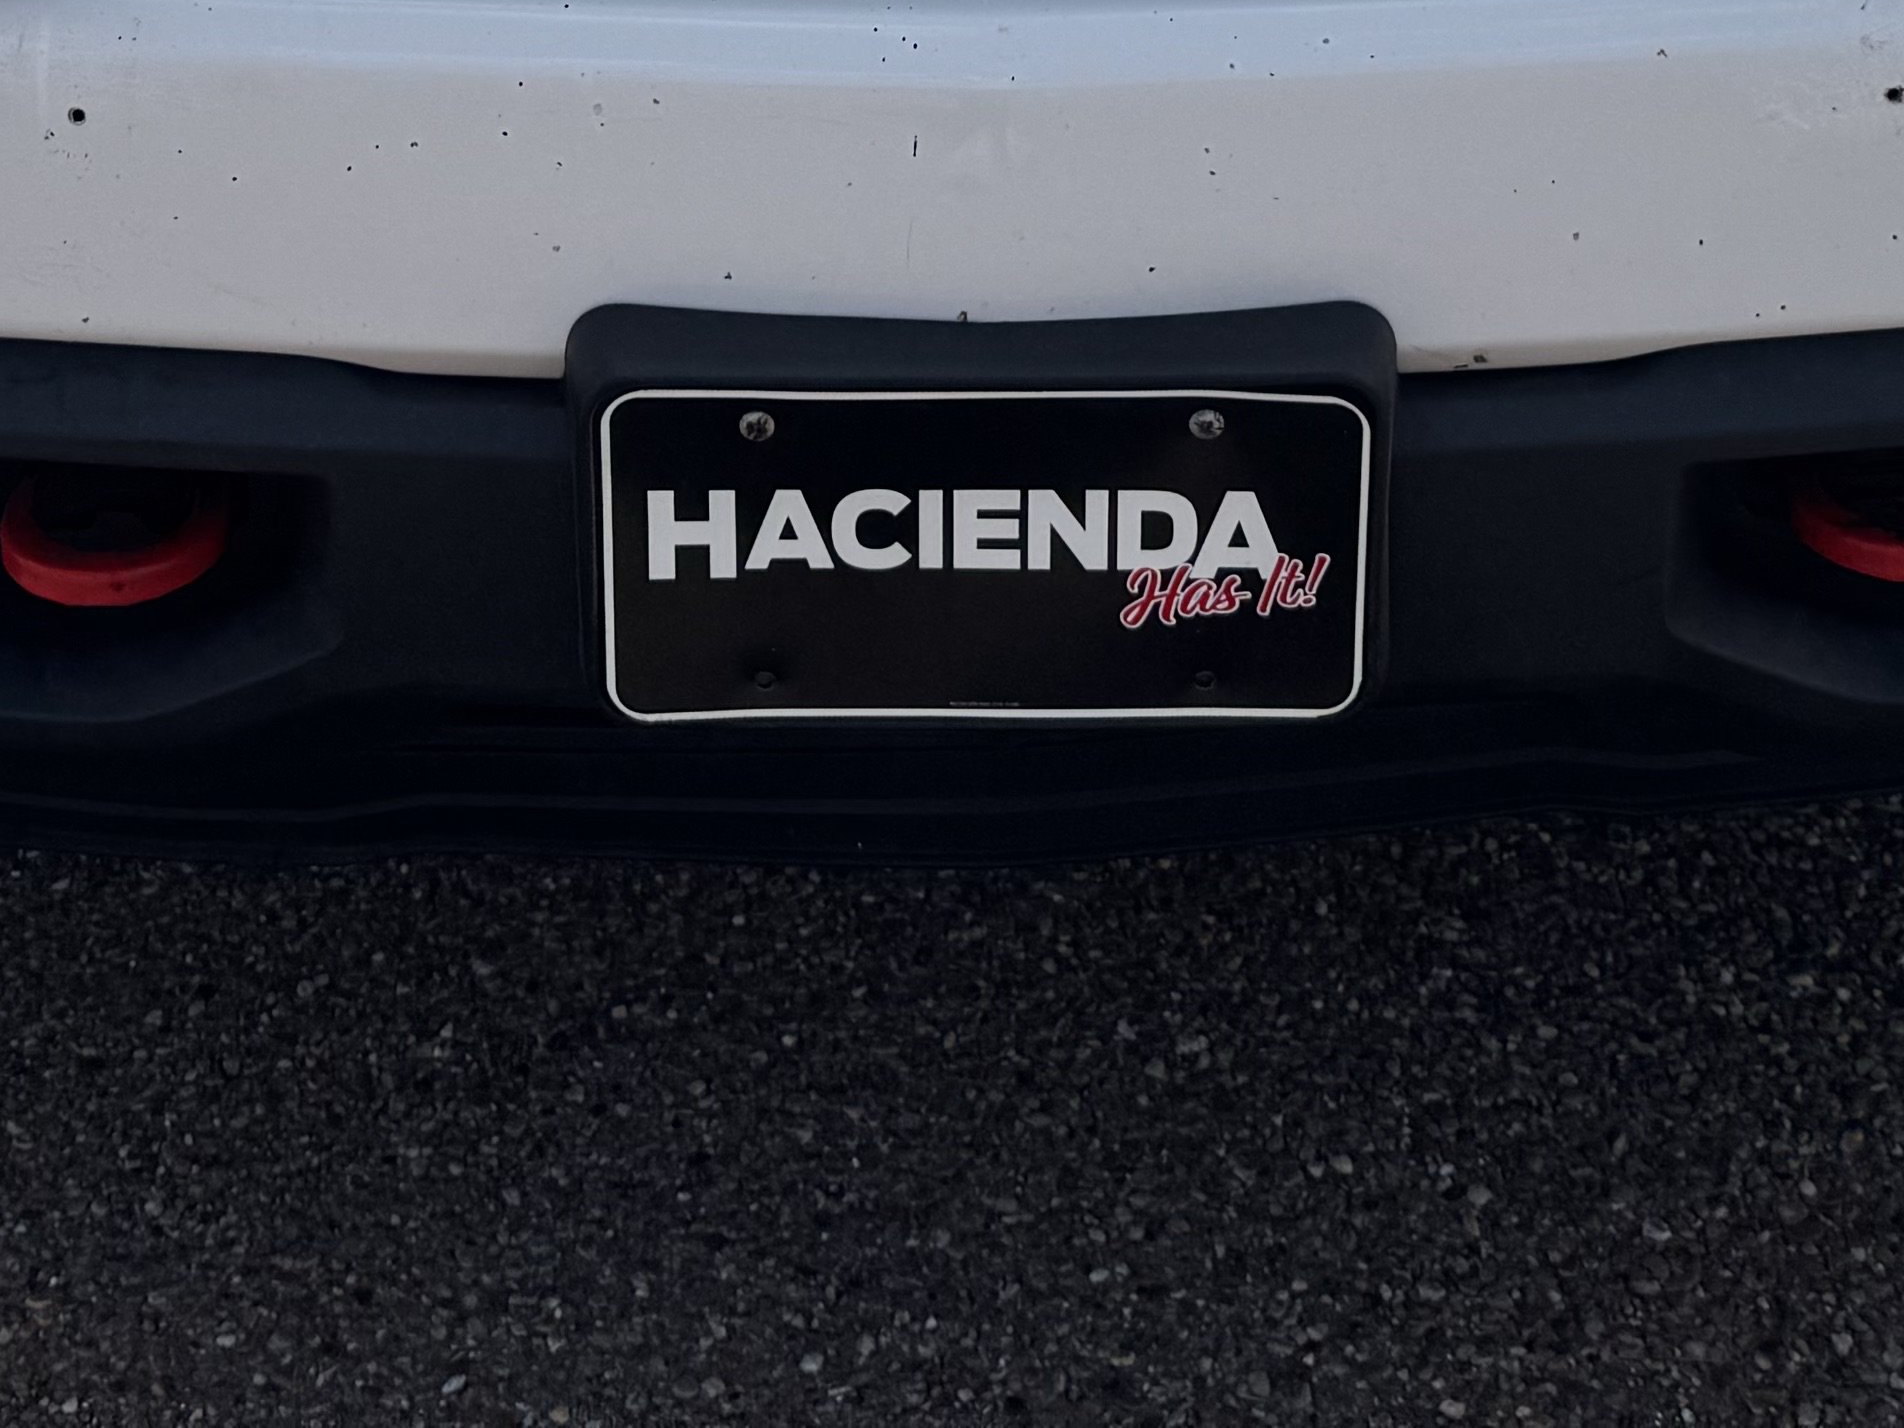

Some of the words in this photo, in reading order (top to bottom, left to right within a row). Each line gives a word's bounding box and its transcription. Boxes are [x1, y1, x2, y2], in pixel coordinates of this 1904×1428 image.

[646, 488, 1280, 580] HACIENDA
[1121, 560, 1252, 629] Has
[1256, 552, 1331, 616] It!
